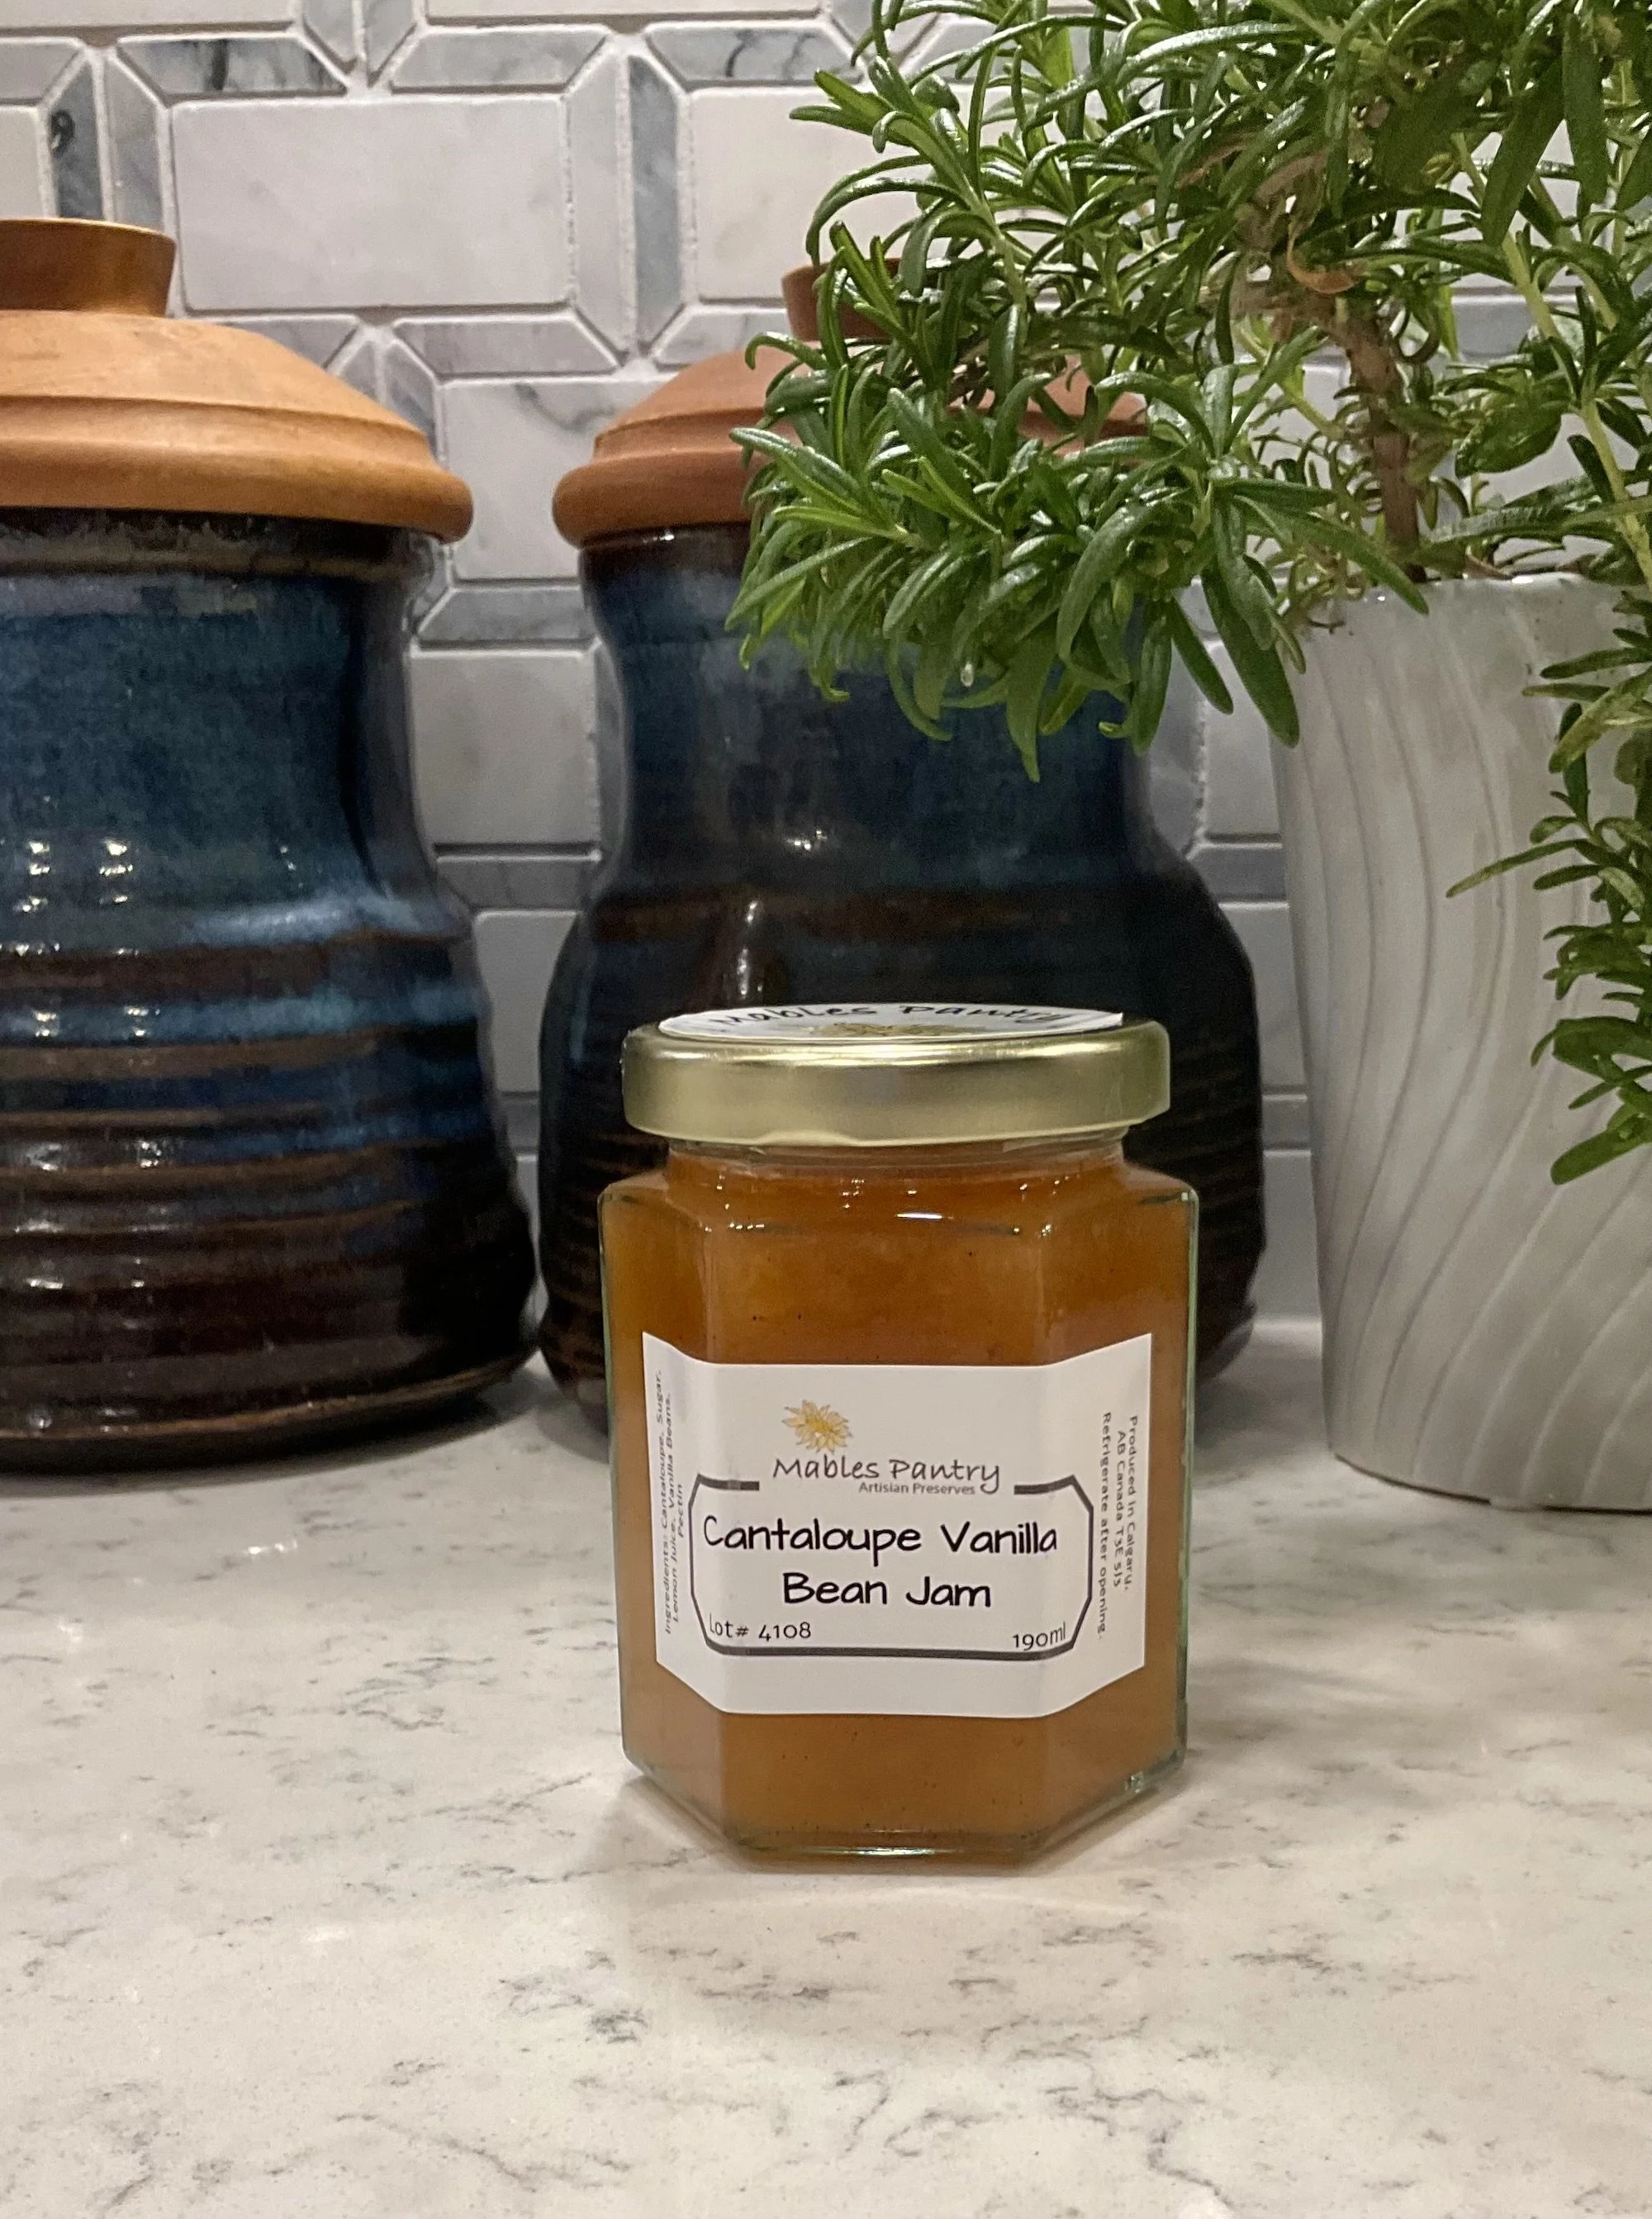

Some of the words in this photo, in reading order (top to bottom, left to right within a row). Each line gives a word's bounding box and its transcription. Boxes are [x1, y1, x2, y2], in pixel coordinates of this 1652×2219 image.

[709, 1007, 878, 1025] Mables
[900, 1005, 1073, 1024] Pantry
[1100, 1412, 1111, 1512] Refrigerate
[1117, 1431, 1126, 1455] AB
[1127, 1415, 1138, 1496] Produced
[666, 1455, 675, 1509] Vanilla
[773, 1454, 879, 1480] Mables
[890, 1459, 999, 1494] Pantry
[912, 1482, 975, 1494] Preserves
[1116, 1461, 1125, 1521] Canada
[704, 1515, 922, 1566] Cantaloupe
[941, 1522, 1057, 1554] Vanilla
[1100, 1518, 1109, 1561] after
[783, 1572, 887, 1604] Bean
[906, 1576, 991, 1607] Jam
[710, 1612, 749, 1637] Lot#
[758, 1621, 811, 1642] 4108
[1013, 1621, 1066, 1651] 190ml
